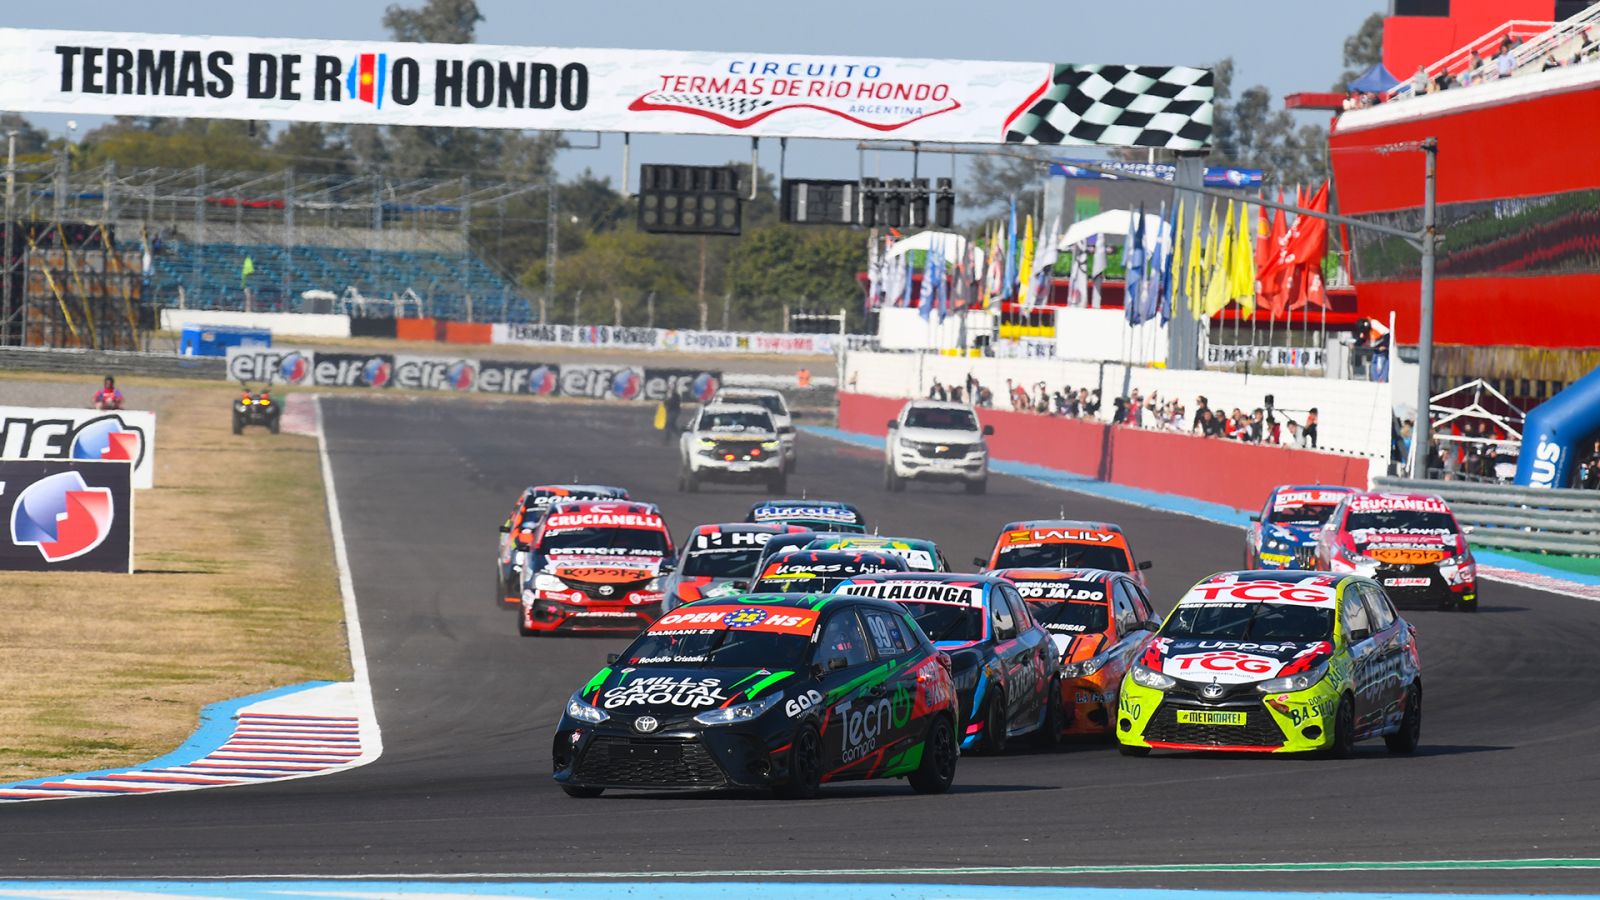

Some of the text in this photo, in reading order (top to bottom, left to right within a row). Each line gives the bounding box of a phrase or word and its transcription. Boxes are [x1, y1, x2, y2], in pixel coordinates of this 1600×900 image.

[54, 46, 234, 99] TERMAS
[247, 53, 301, 100] DE
[435, 59, 589, 111] HONDO
[729, 61, 881, 78] CIRCUITO
[660, 75, 765, 95] TERMAS
[771, 79, 803, 97] DE
[857, 82, 949, 101] HONDO
[848, 105, 924, 115] ARGENTINA
[232, 354, 279, 383] elf
[315, 360, 362, 385] elf
[401, 361, 448, 389] elf
[480, 367, 528, 393] elf
[562, 369, 612, 396] elf
[0, 418, 74, 459] lf
[1351, 498, 1447, 512] CRUCIANELLI
[547, 514, 663, 528] CRUCIANELLI
[1034, 530, 1115, 542] LALILY
[1375, 549, 1441, 560] Kubota
[847, 585, 972, 605] VILLALONGA
[1194, 584, 1330, 603] TCG
[659, 611, 813, 628] OPEN 25 HS!
[867, 616, 892, 648] 99
[1198, 641, 1297, 652] Upper
[638, 656, 672, 664] Rodolfo
[1175, 655, 1272, 674] TCG
[629, 677, 721, 687] MILLS
[604, 685, 728, 701] CAPITAL
[604, 692, 716, 709] GROUP
[1182, 712, 1241, 724] #METAMATE!
[1291, 699, 1335, 727] BASILIO
[842, 737, 876, 763] compro
